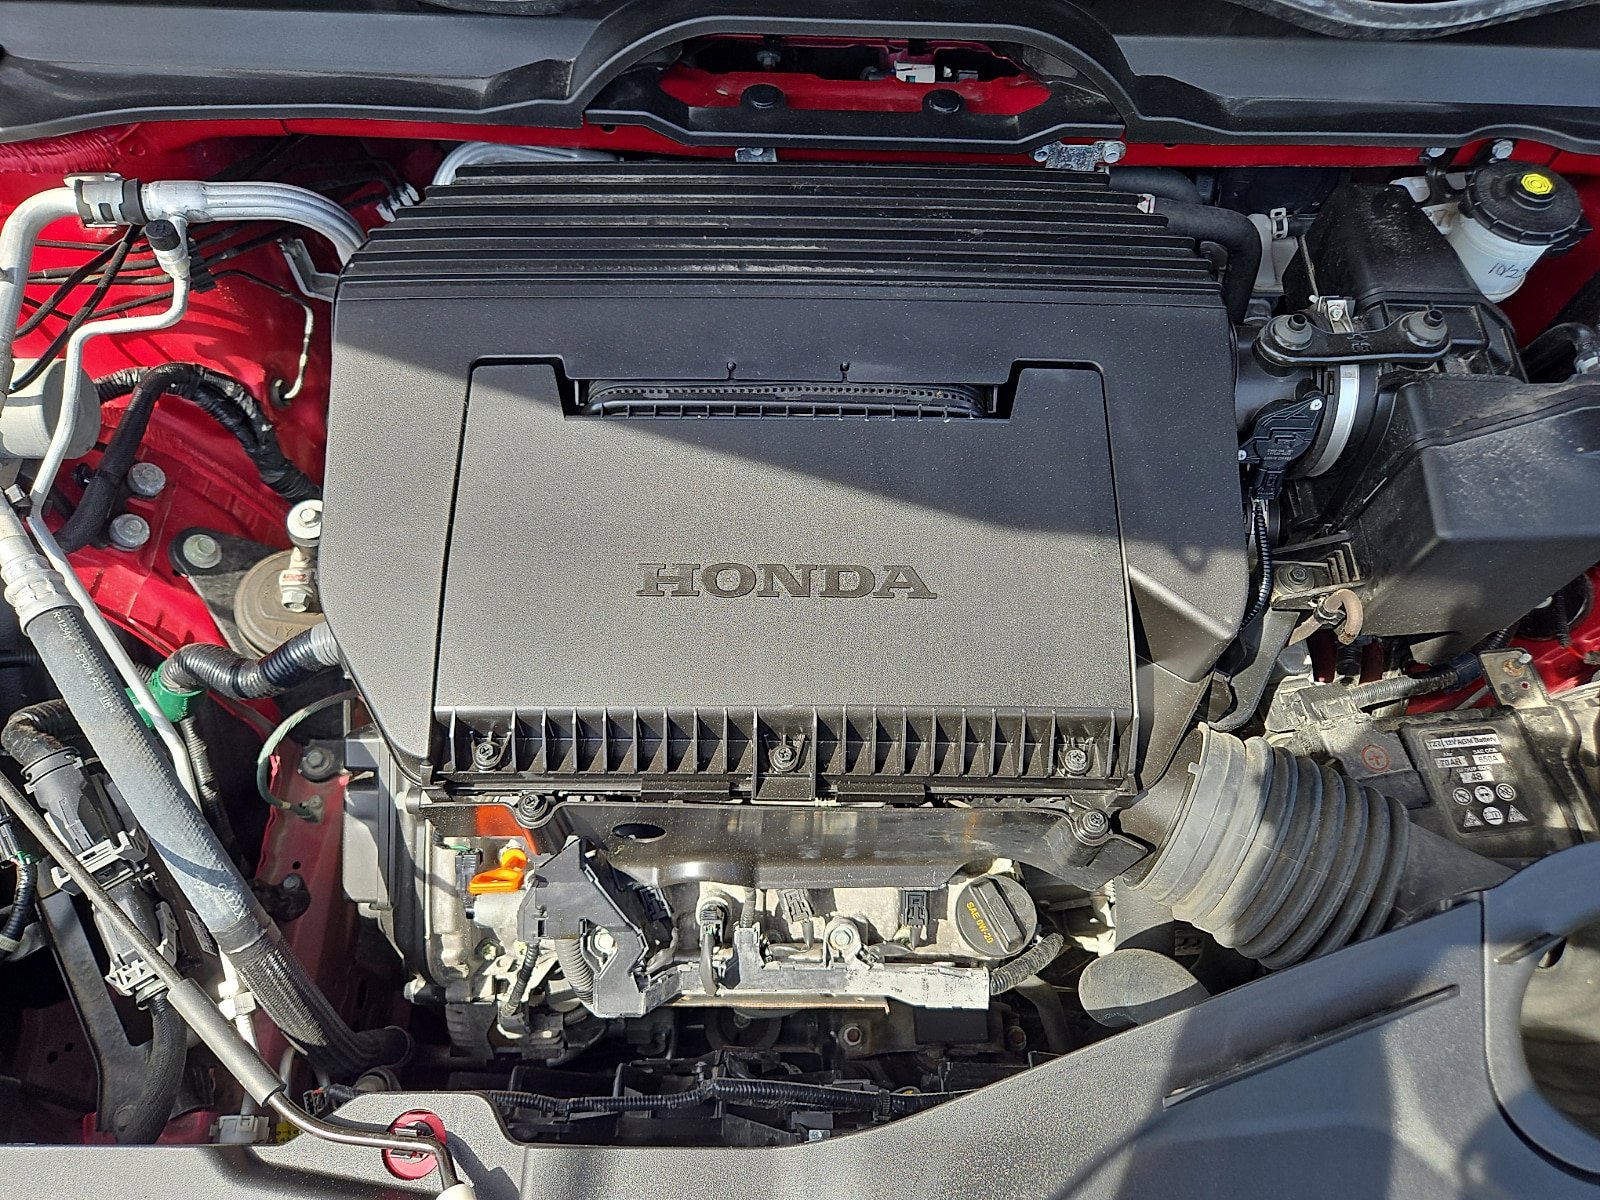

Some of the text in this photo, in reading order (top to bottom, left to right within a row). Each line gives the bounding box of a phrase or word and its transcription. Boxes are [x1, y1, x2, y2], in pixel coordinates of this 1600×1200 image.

[636, 562, 937, 599] HONDA
[1471, 772, 1483, 781] 48
[966, 901, 994, 944] SAE 0W-20
